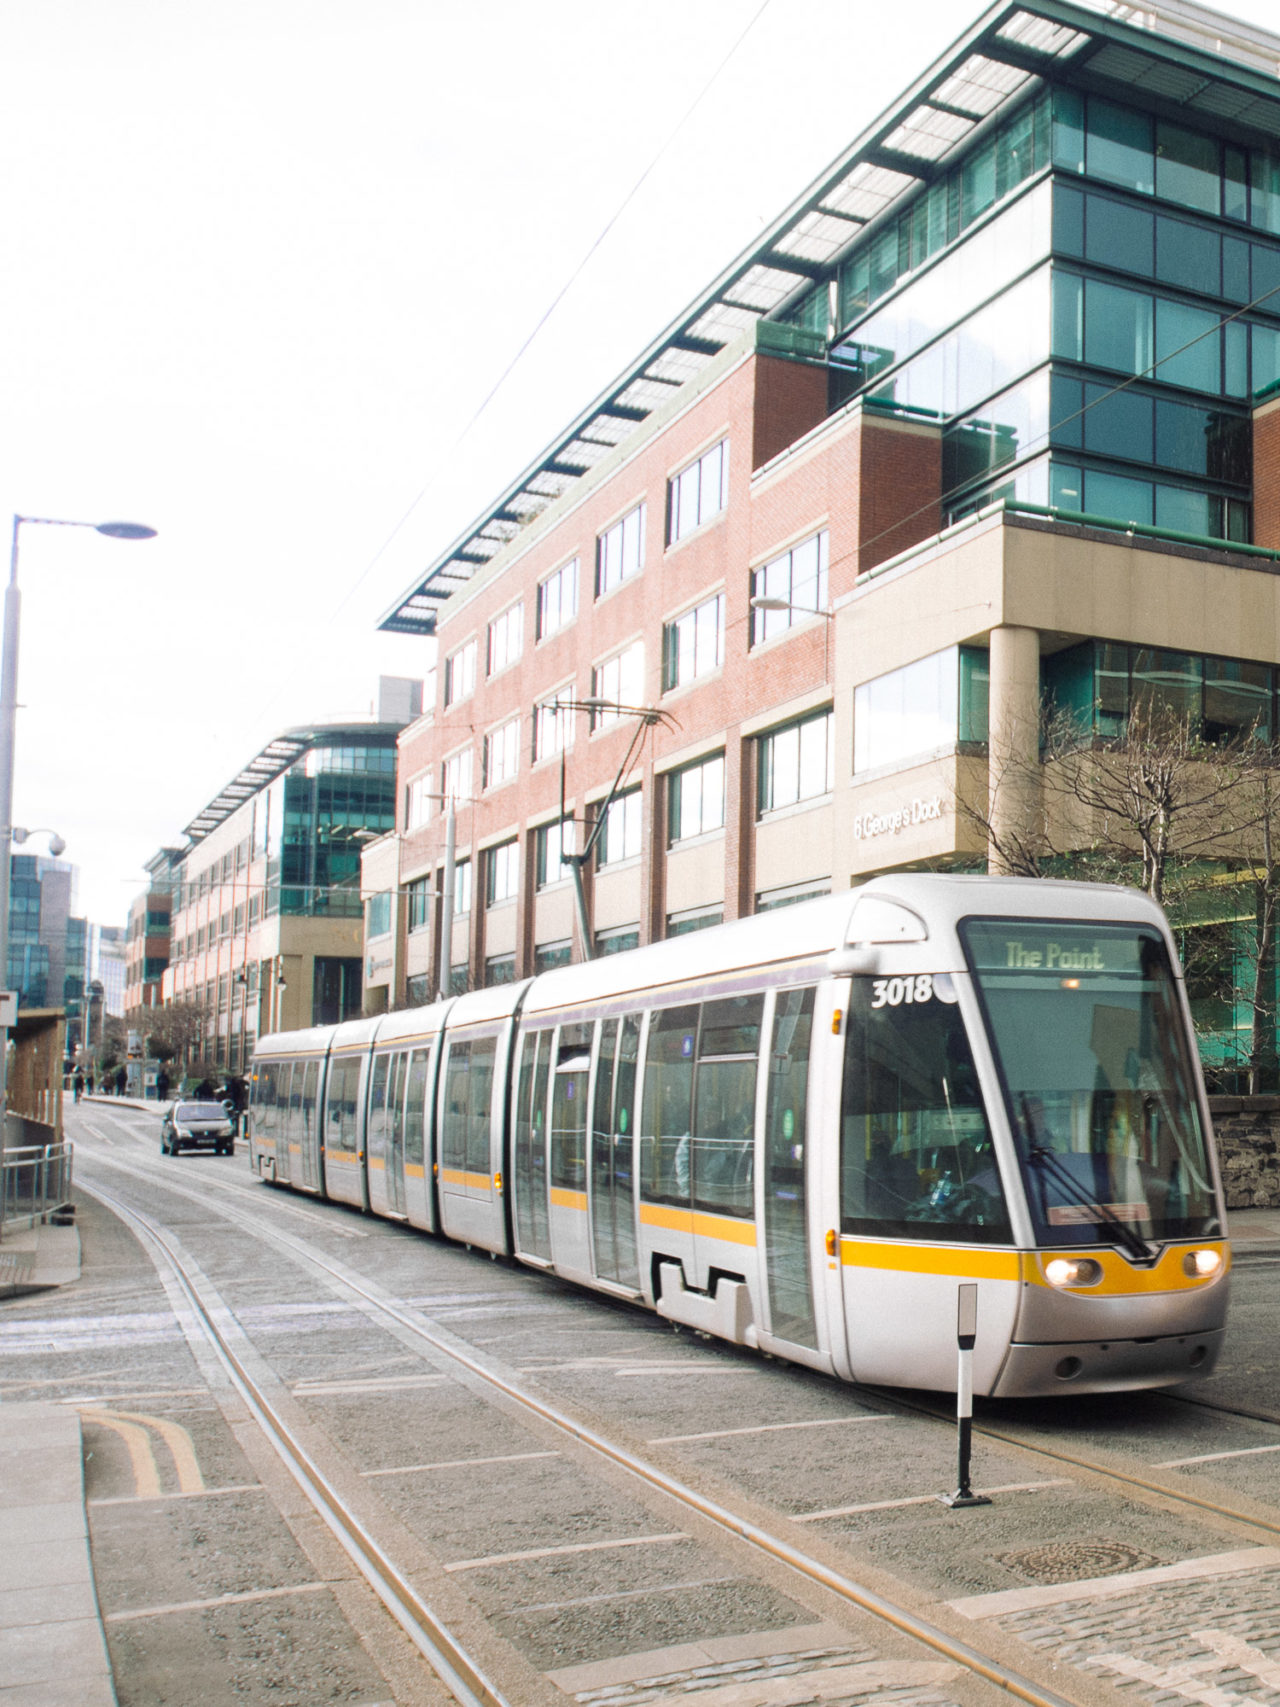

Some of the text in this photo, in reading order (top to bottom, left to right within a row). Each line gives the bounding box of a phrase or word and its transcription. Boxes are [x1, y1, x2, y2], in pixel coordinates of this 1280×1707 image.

[912, 796, 943, 825] Dock
[1006, 942, 1105, 969] The Point
[871, 974, 933, 1009] 3018
